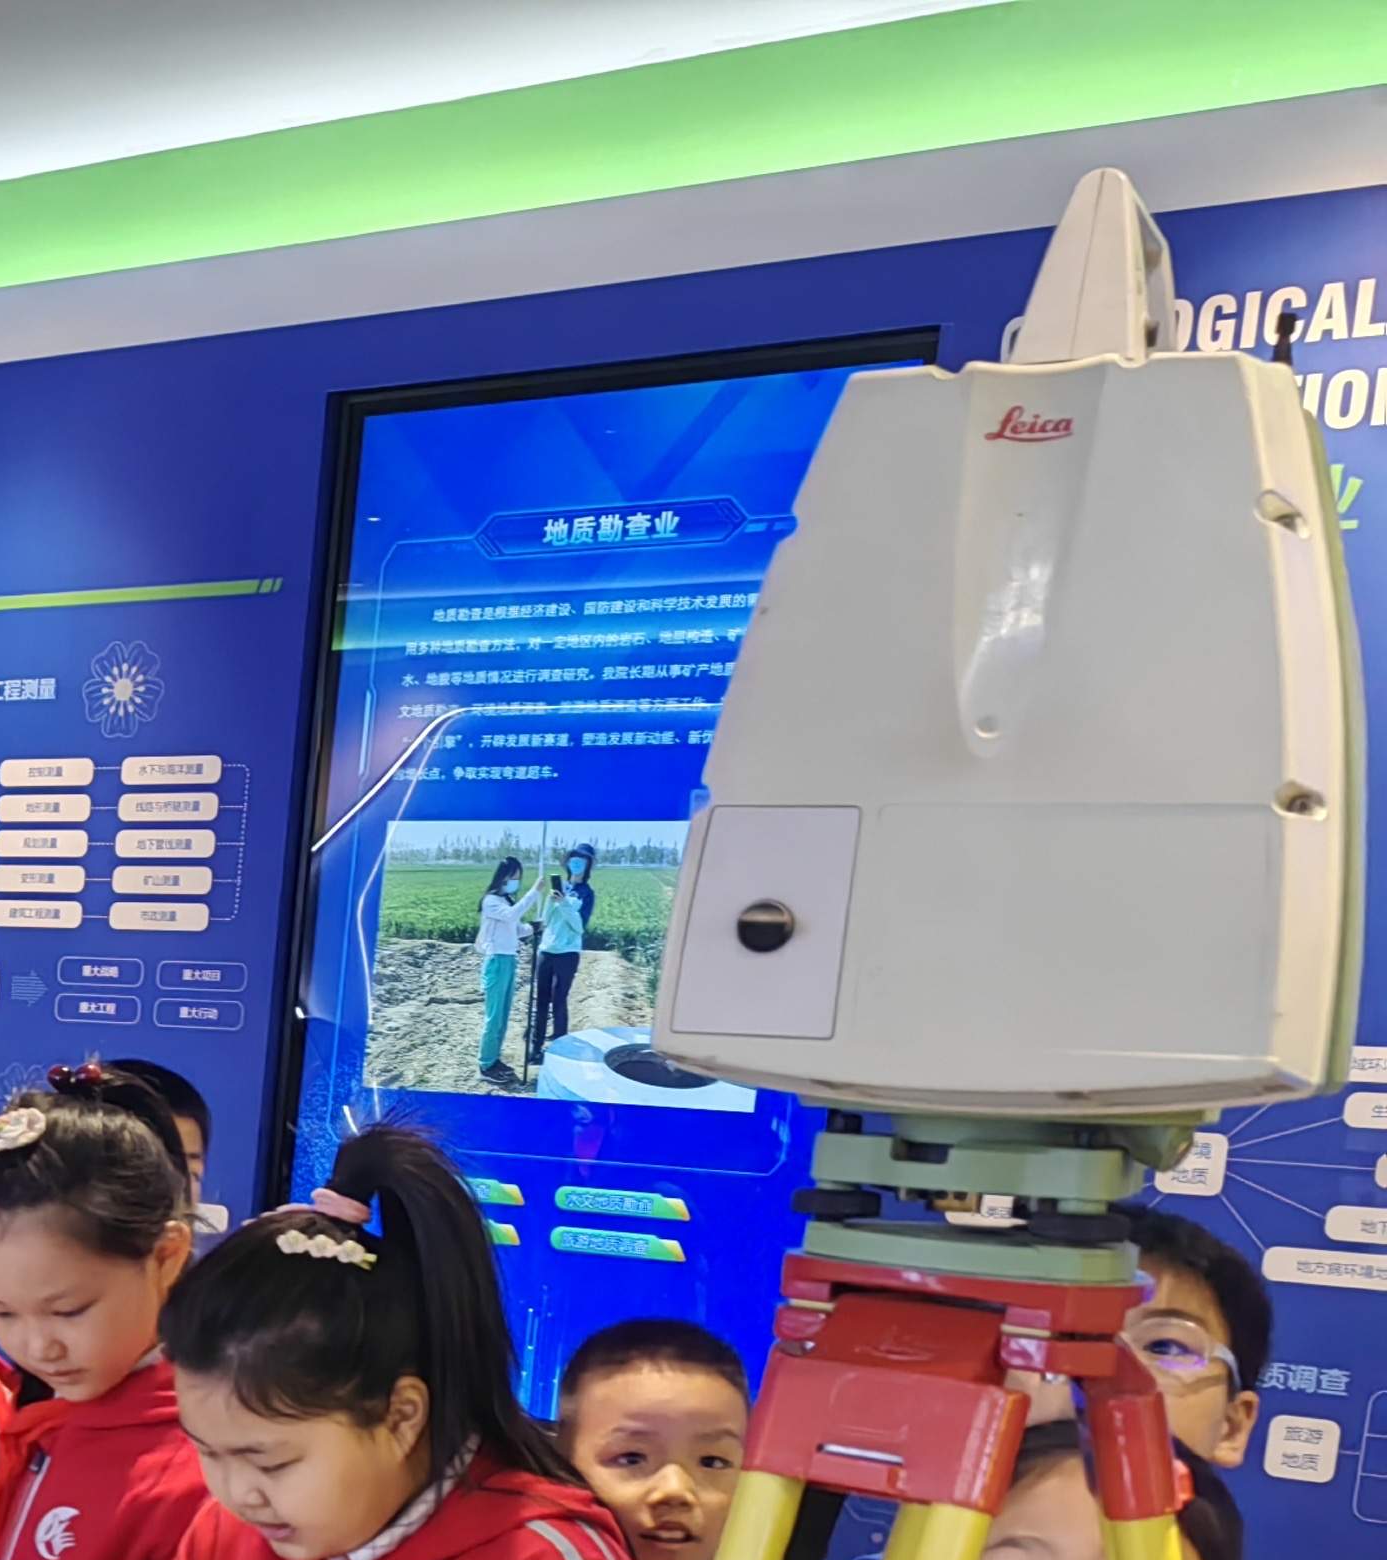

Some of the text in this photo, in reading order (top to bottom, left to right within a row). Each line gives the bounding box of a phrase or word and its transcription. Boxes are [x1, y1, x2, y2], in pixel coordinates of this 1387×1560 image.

[1173, 278, 1387, 352] OGICAL
[984, 405, 1075, 443] Leica
[543, 510, 680, 547] 地质勘查业
[1256, 1361, 1352, 1397] 质调查
